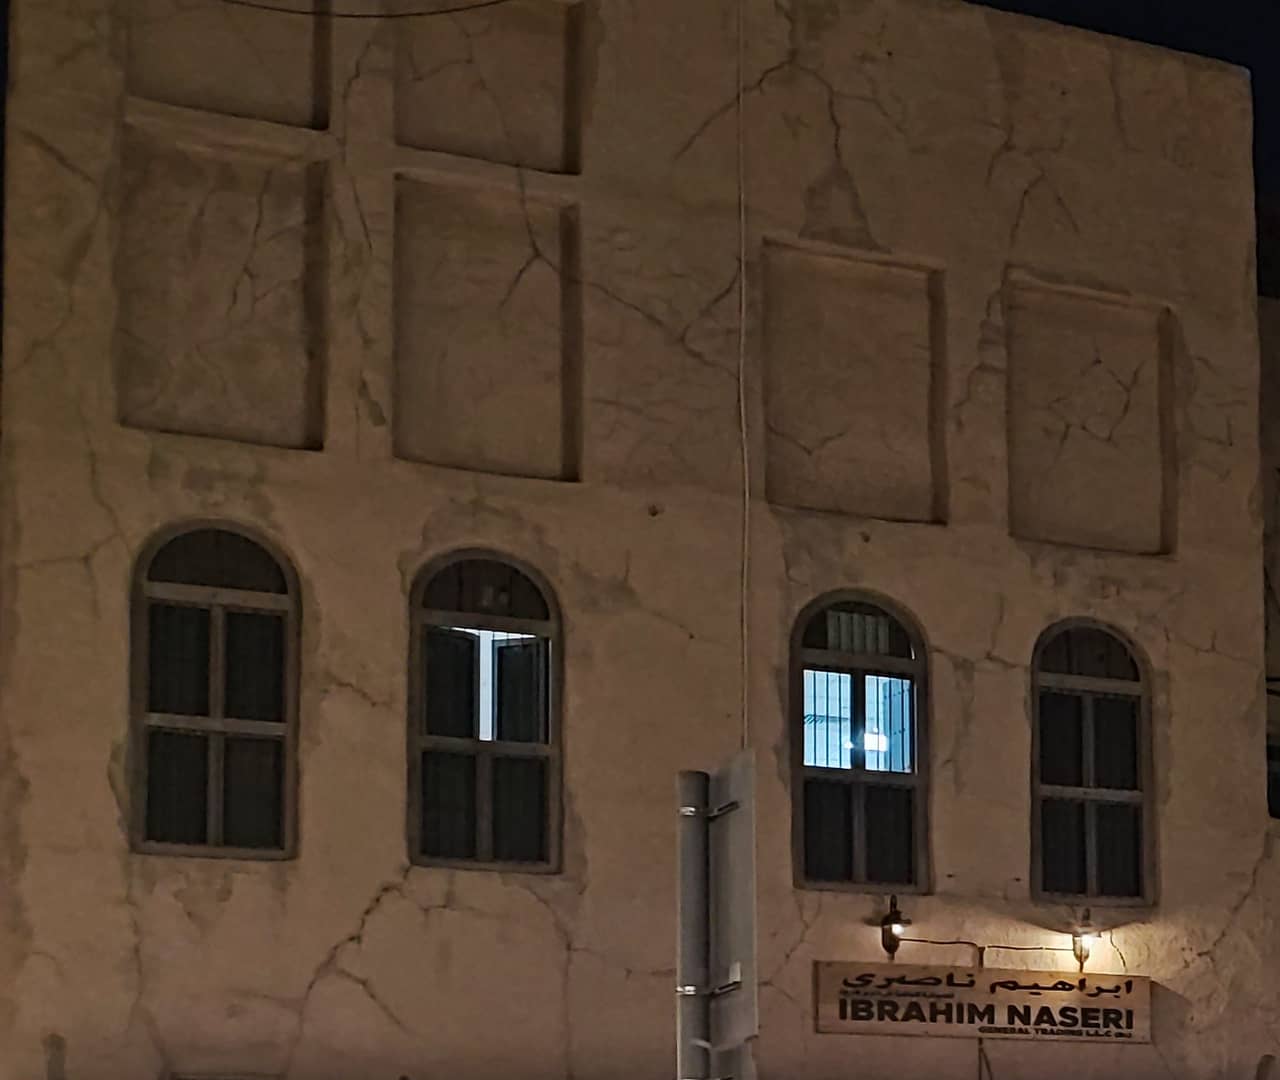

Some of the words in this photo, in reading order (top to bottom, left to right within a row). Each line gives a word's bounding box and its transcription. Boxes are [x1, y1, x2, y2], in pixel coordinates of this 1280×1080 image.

[838, 998, 995, 1025] IBRAHIM
[1006, 1004, 1134, 1030] NASERI
[978, 1026, 1031, 1035] GENERAL
[1033, 1028, 1083, 1037] TRADING
